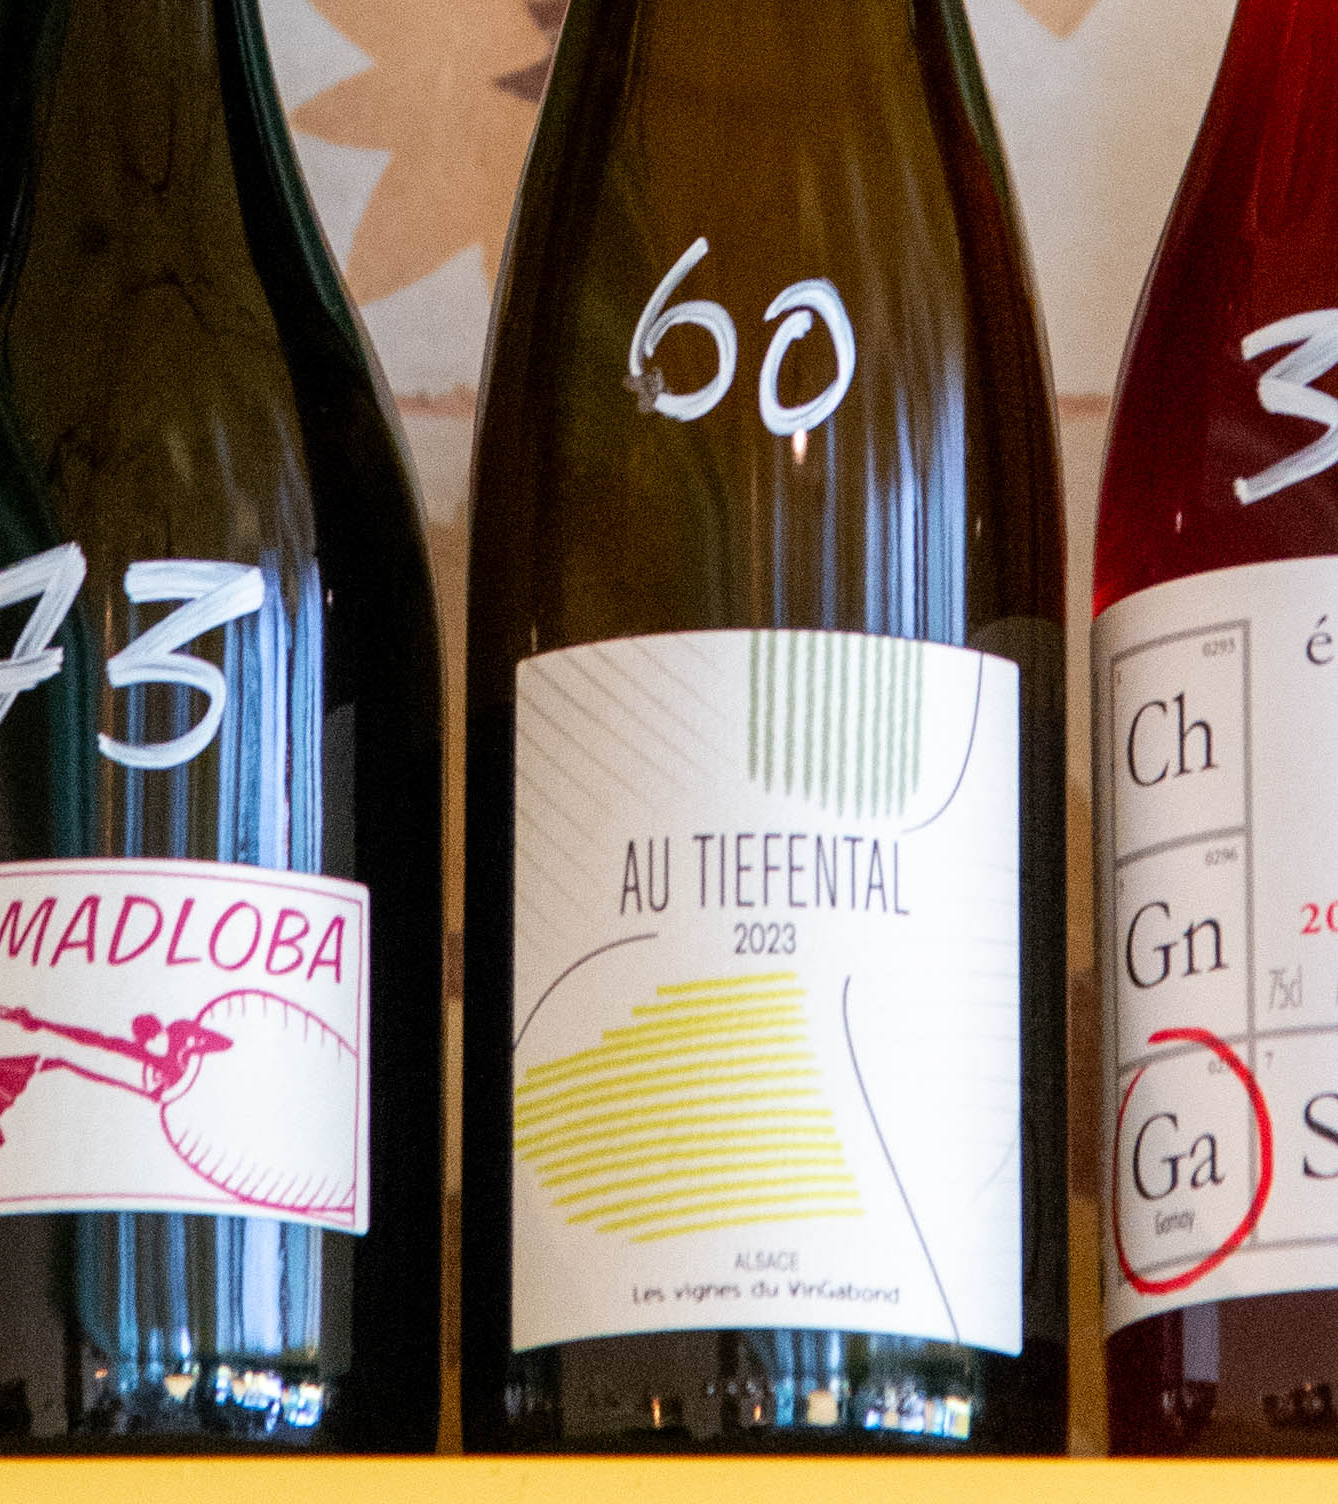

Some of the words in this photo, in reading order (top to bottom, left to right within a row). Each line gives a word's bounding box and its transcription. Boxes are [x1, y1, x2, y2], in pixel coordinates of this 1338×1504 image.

[624, 236, 857, 438] 60
[1126, 691, 1219, 788] Ch
[621, 836, 670, 915] AU
[692, 833, 910, 916] TIEFENTAL
[733, 921, 797, 955] 2023
[1125, 899, 1230, 991] Gn
[1132, 1110, 1227, 1202] Ga
[632, 1285, 666, 1305] Les
[675, 1281, 742, 1304] vignes
[750, 1278, 779, 1299] du
[735, 1250, 799, 1273] ALSACE
